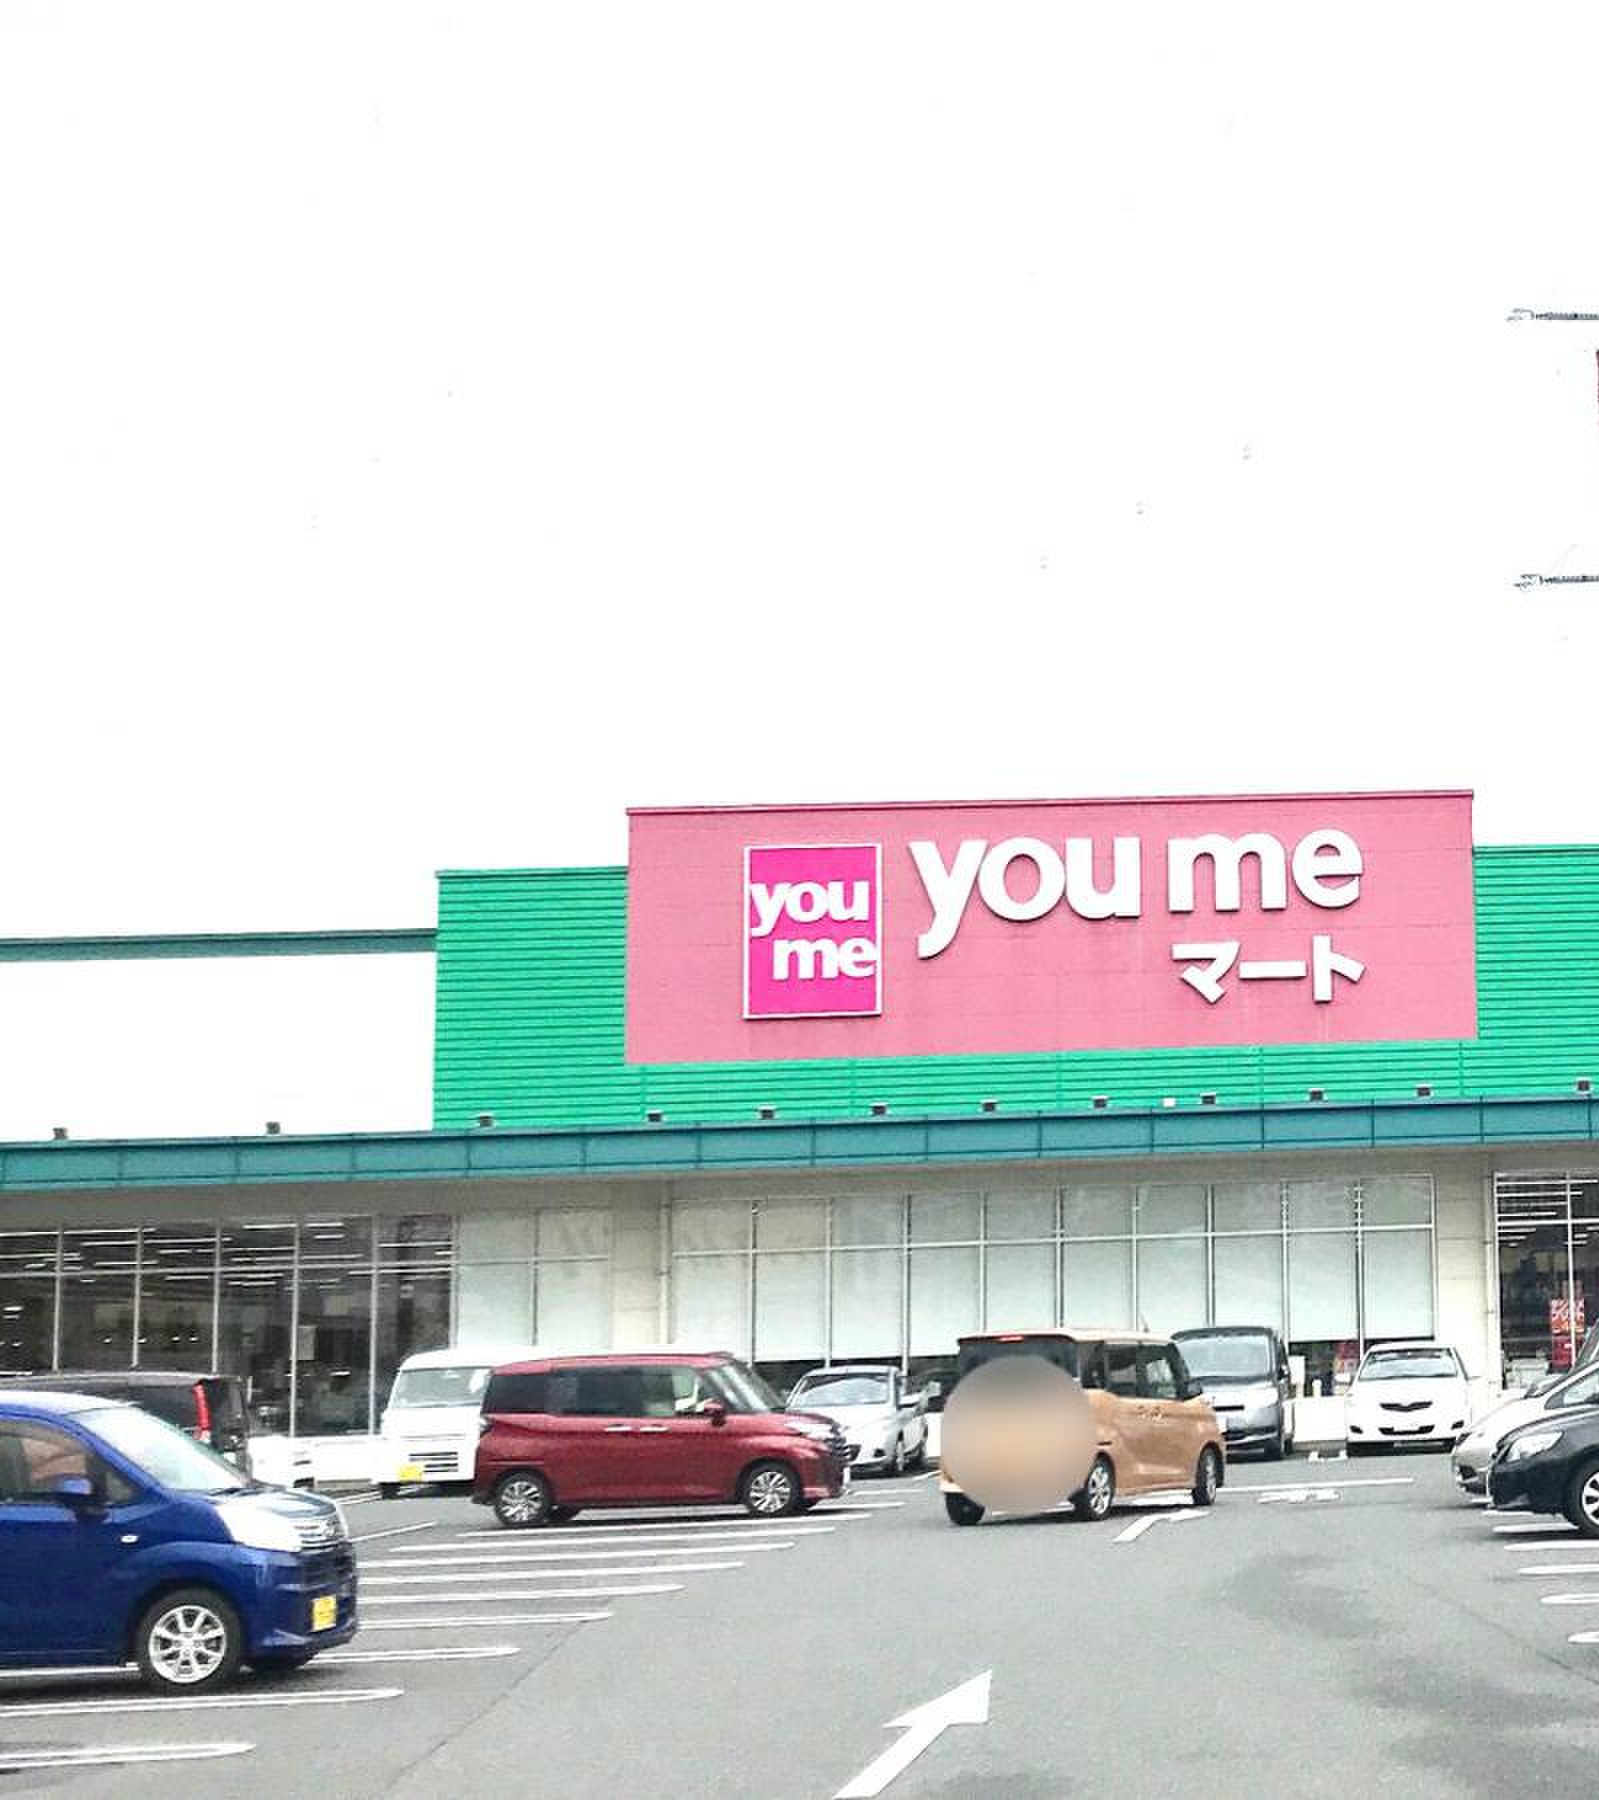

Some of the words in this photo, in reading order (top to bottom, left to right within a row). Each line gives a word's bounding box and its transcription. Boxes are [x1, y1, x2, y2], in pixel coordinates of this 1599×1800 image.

[750, 879, 870, 938] you
[909, 837, 1141, 957] you
[1168, 829, 1363, 911] me
[773, 937, 877, 981] me
[1172, 935, 1365, 1002] マート
